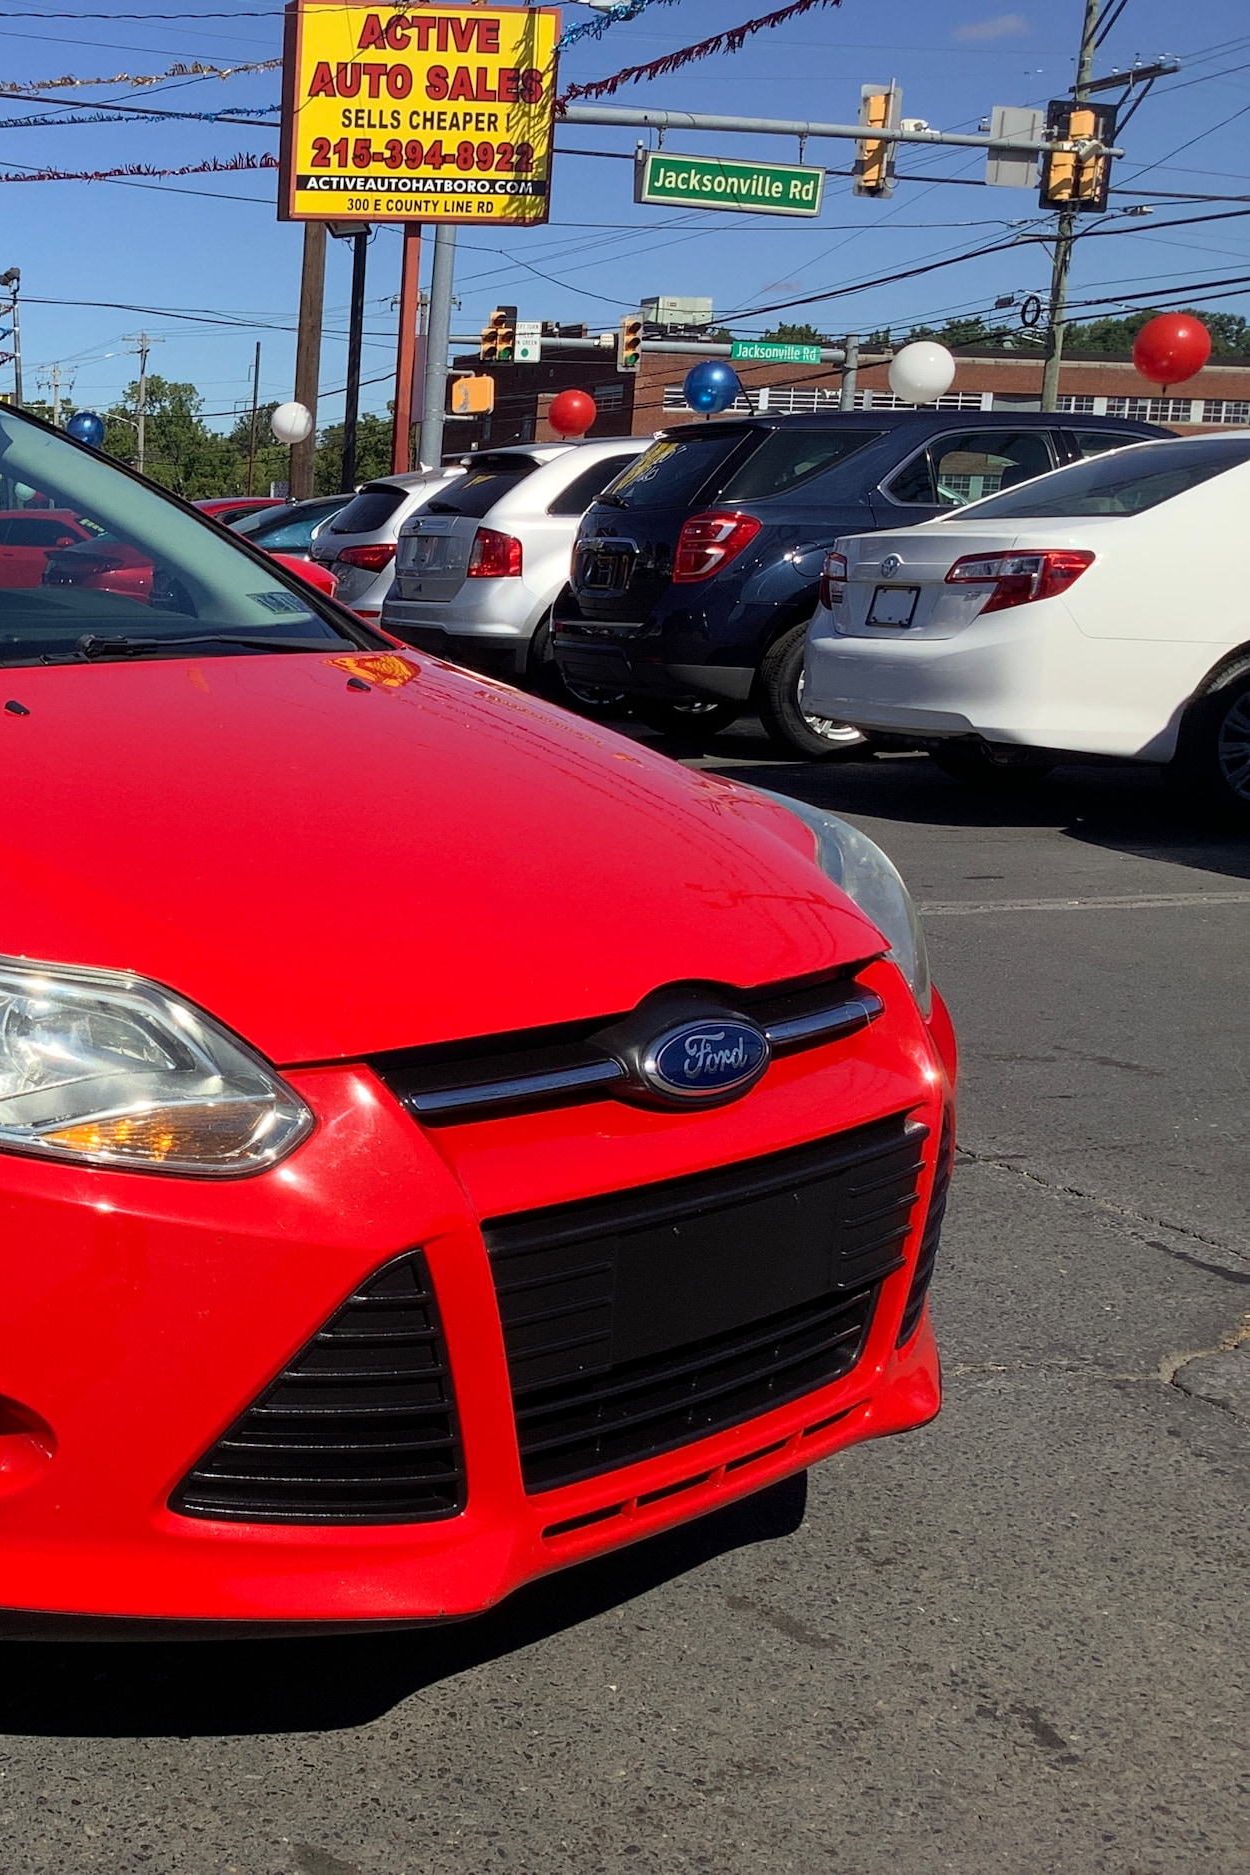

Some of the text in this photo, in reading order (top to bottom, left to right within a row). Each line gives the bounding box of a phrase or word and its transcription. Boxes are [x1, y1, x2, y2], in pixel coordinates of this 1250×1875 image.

[357, 14, 501, 54] ACTIVE
[308, 62, 544, 104] AUTO SALES
[341, 109, 401, 130] SELLS
[408, 111, 498, 132] CHEAPER
[310, 137, 534, 173] 215-394-8922
[306, 177, 533, 195] ACTIVEAUTOHATBORO.COM
[653, 167, 815, 201] Jacksonville Rd
[347, 198, 494, 214] 300 E COUNTY LINE RD
[736, 343, 816, 361] Jacksonville Rd
[683, 1031, 748, 1079] Ford
